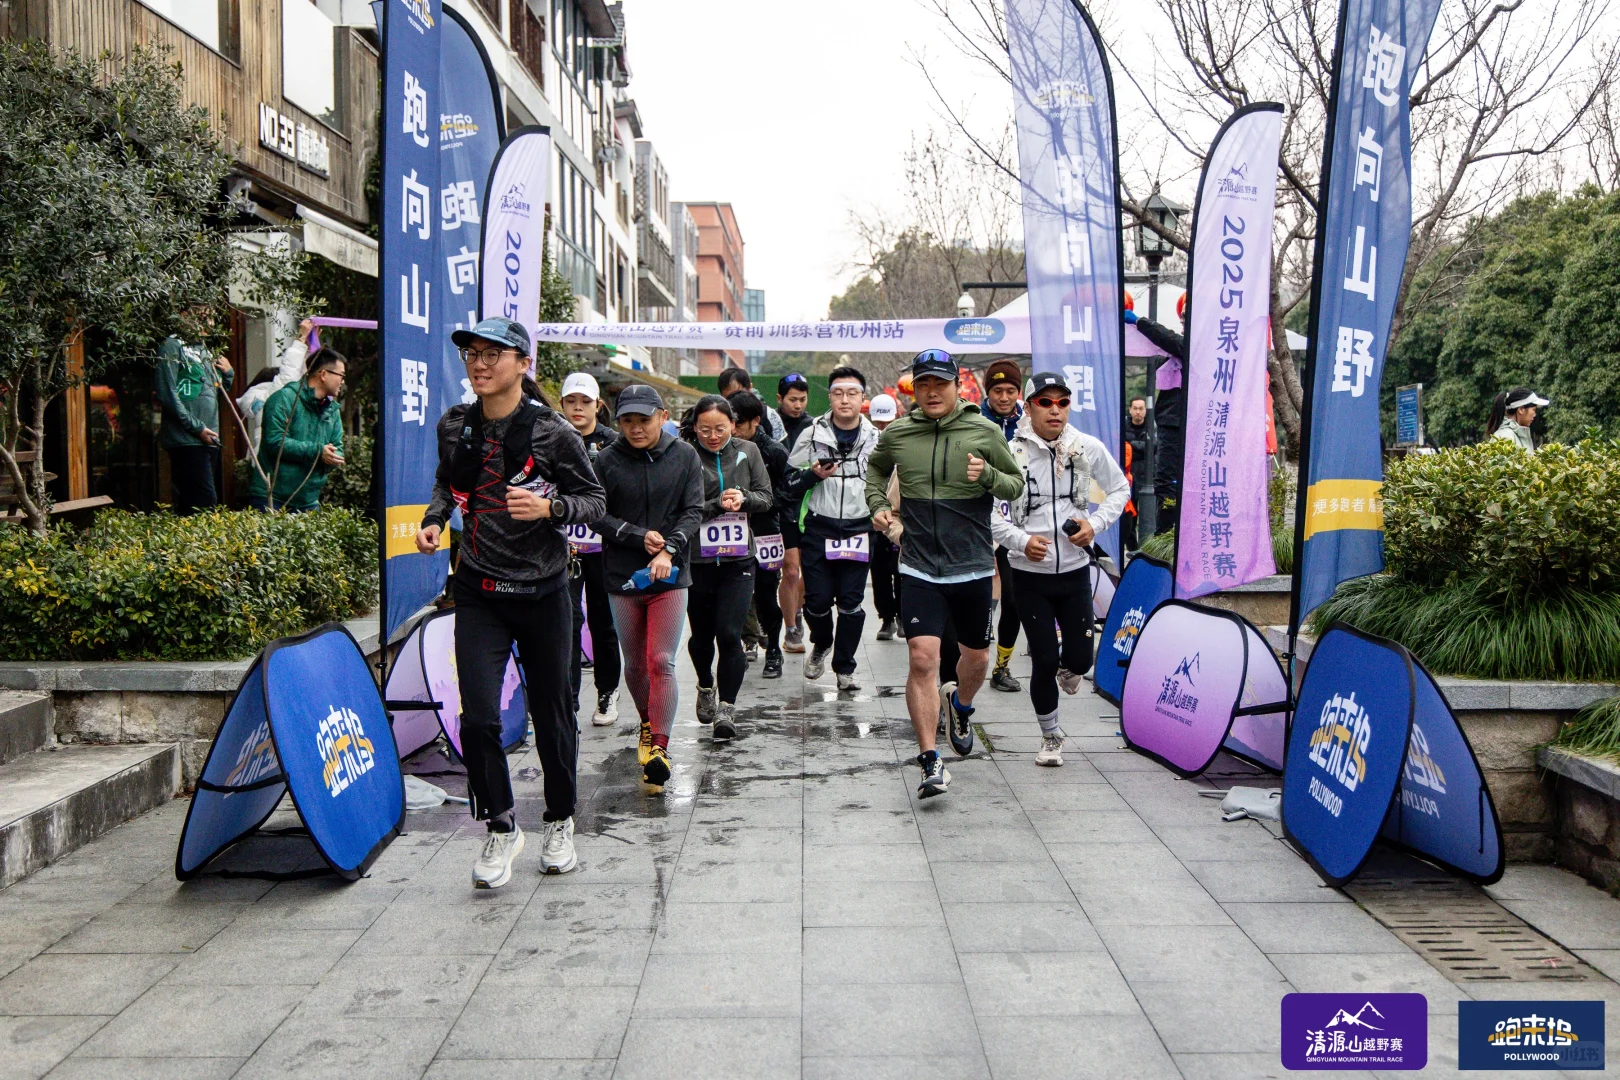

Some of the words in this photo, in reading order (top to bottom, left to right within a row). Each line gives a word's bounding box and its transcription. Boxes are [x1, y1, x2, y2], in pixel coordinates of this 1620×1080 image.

[1331, 22, 1406, 398] 跑向山野
[401, 70, 430, 426] 跑向山野
[707, 525, 743, 542] 013
[1201, 552, 1212, 580] RACE
[1308, 776, 1343, 818] POLLYWOOD
